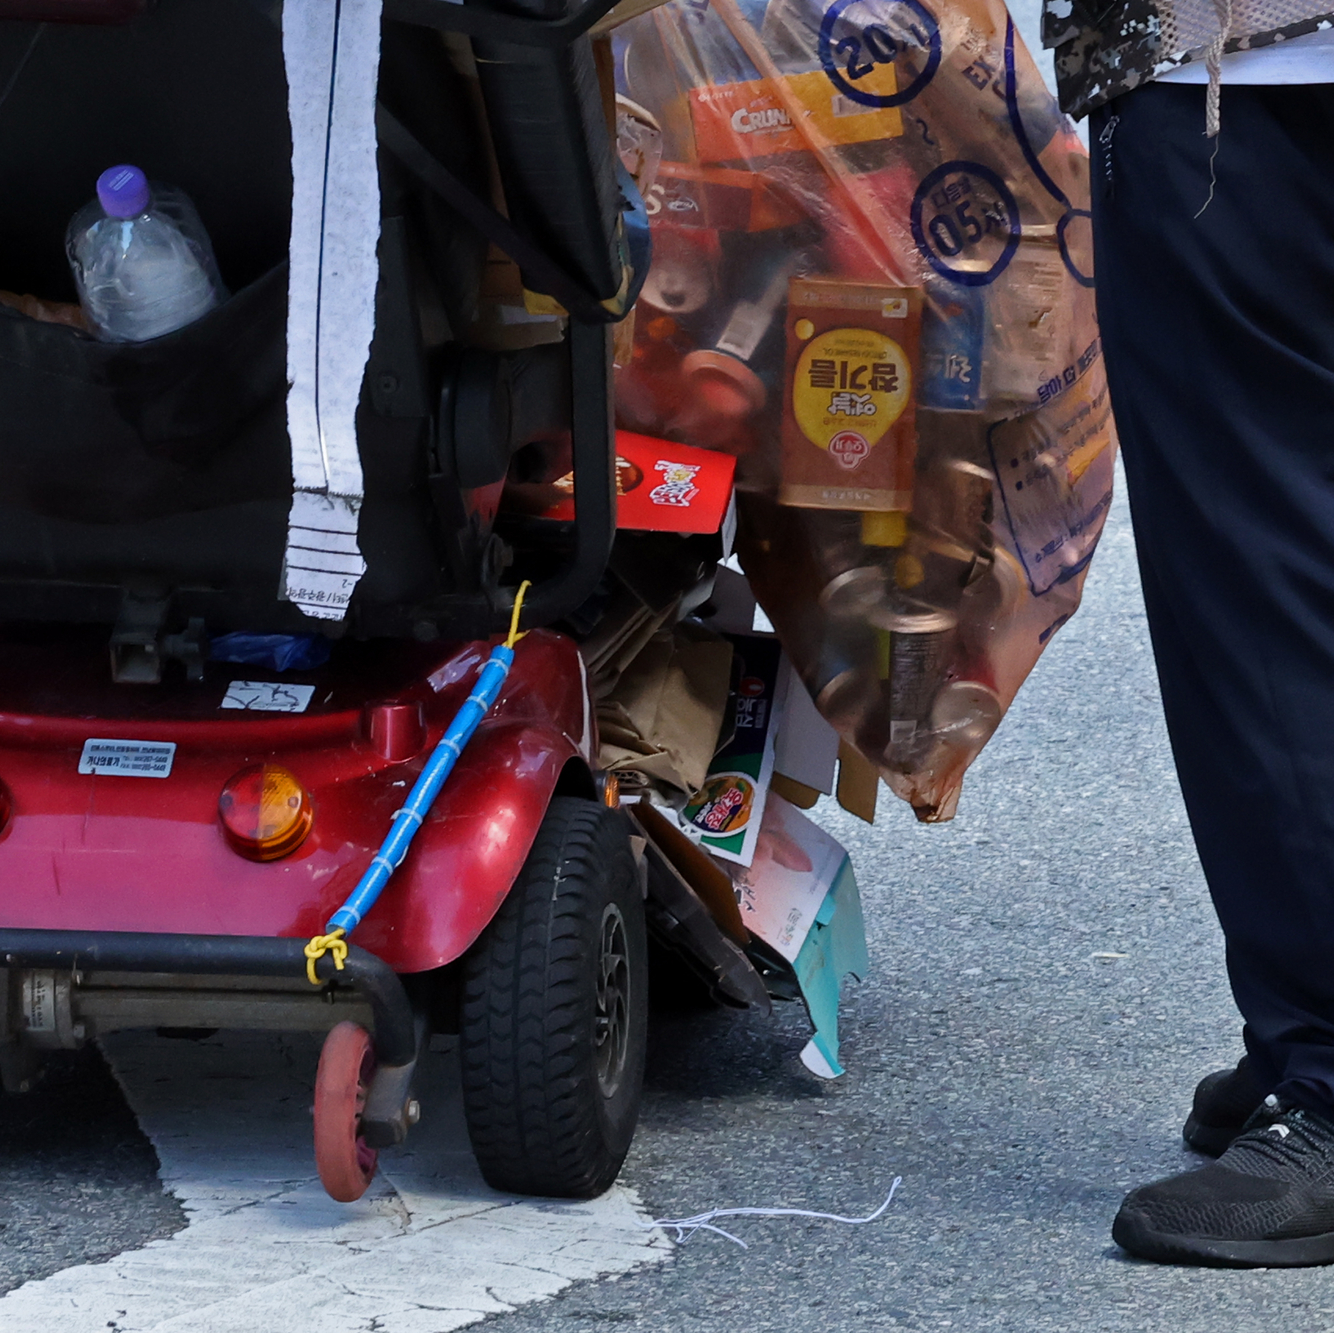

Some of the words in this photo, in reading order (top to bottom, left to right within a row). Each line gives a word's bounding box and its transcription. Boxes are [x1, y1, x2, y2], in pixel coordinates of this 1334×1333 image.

[808, 359, 899, 393] 참기름
[827, 392, 876, 416] 옛날
[706, 788, 744, 830] 육개장
